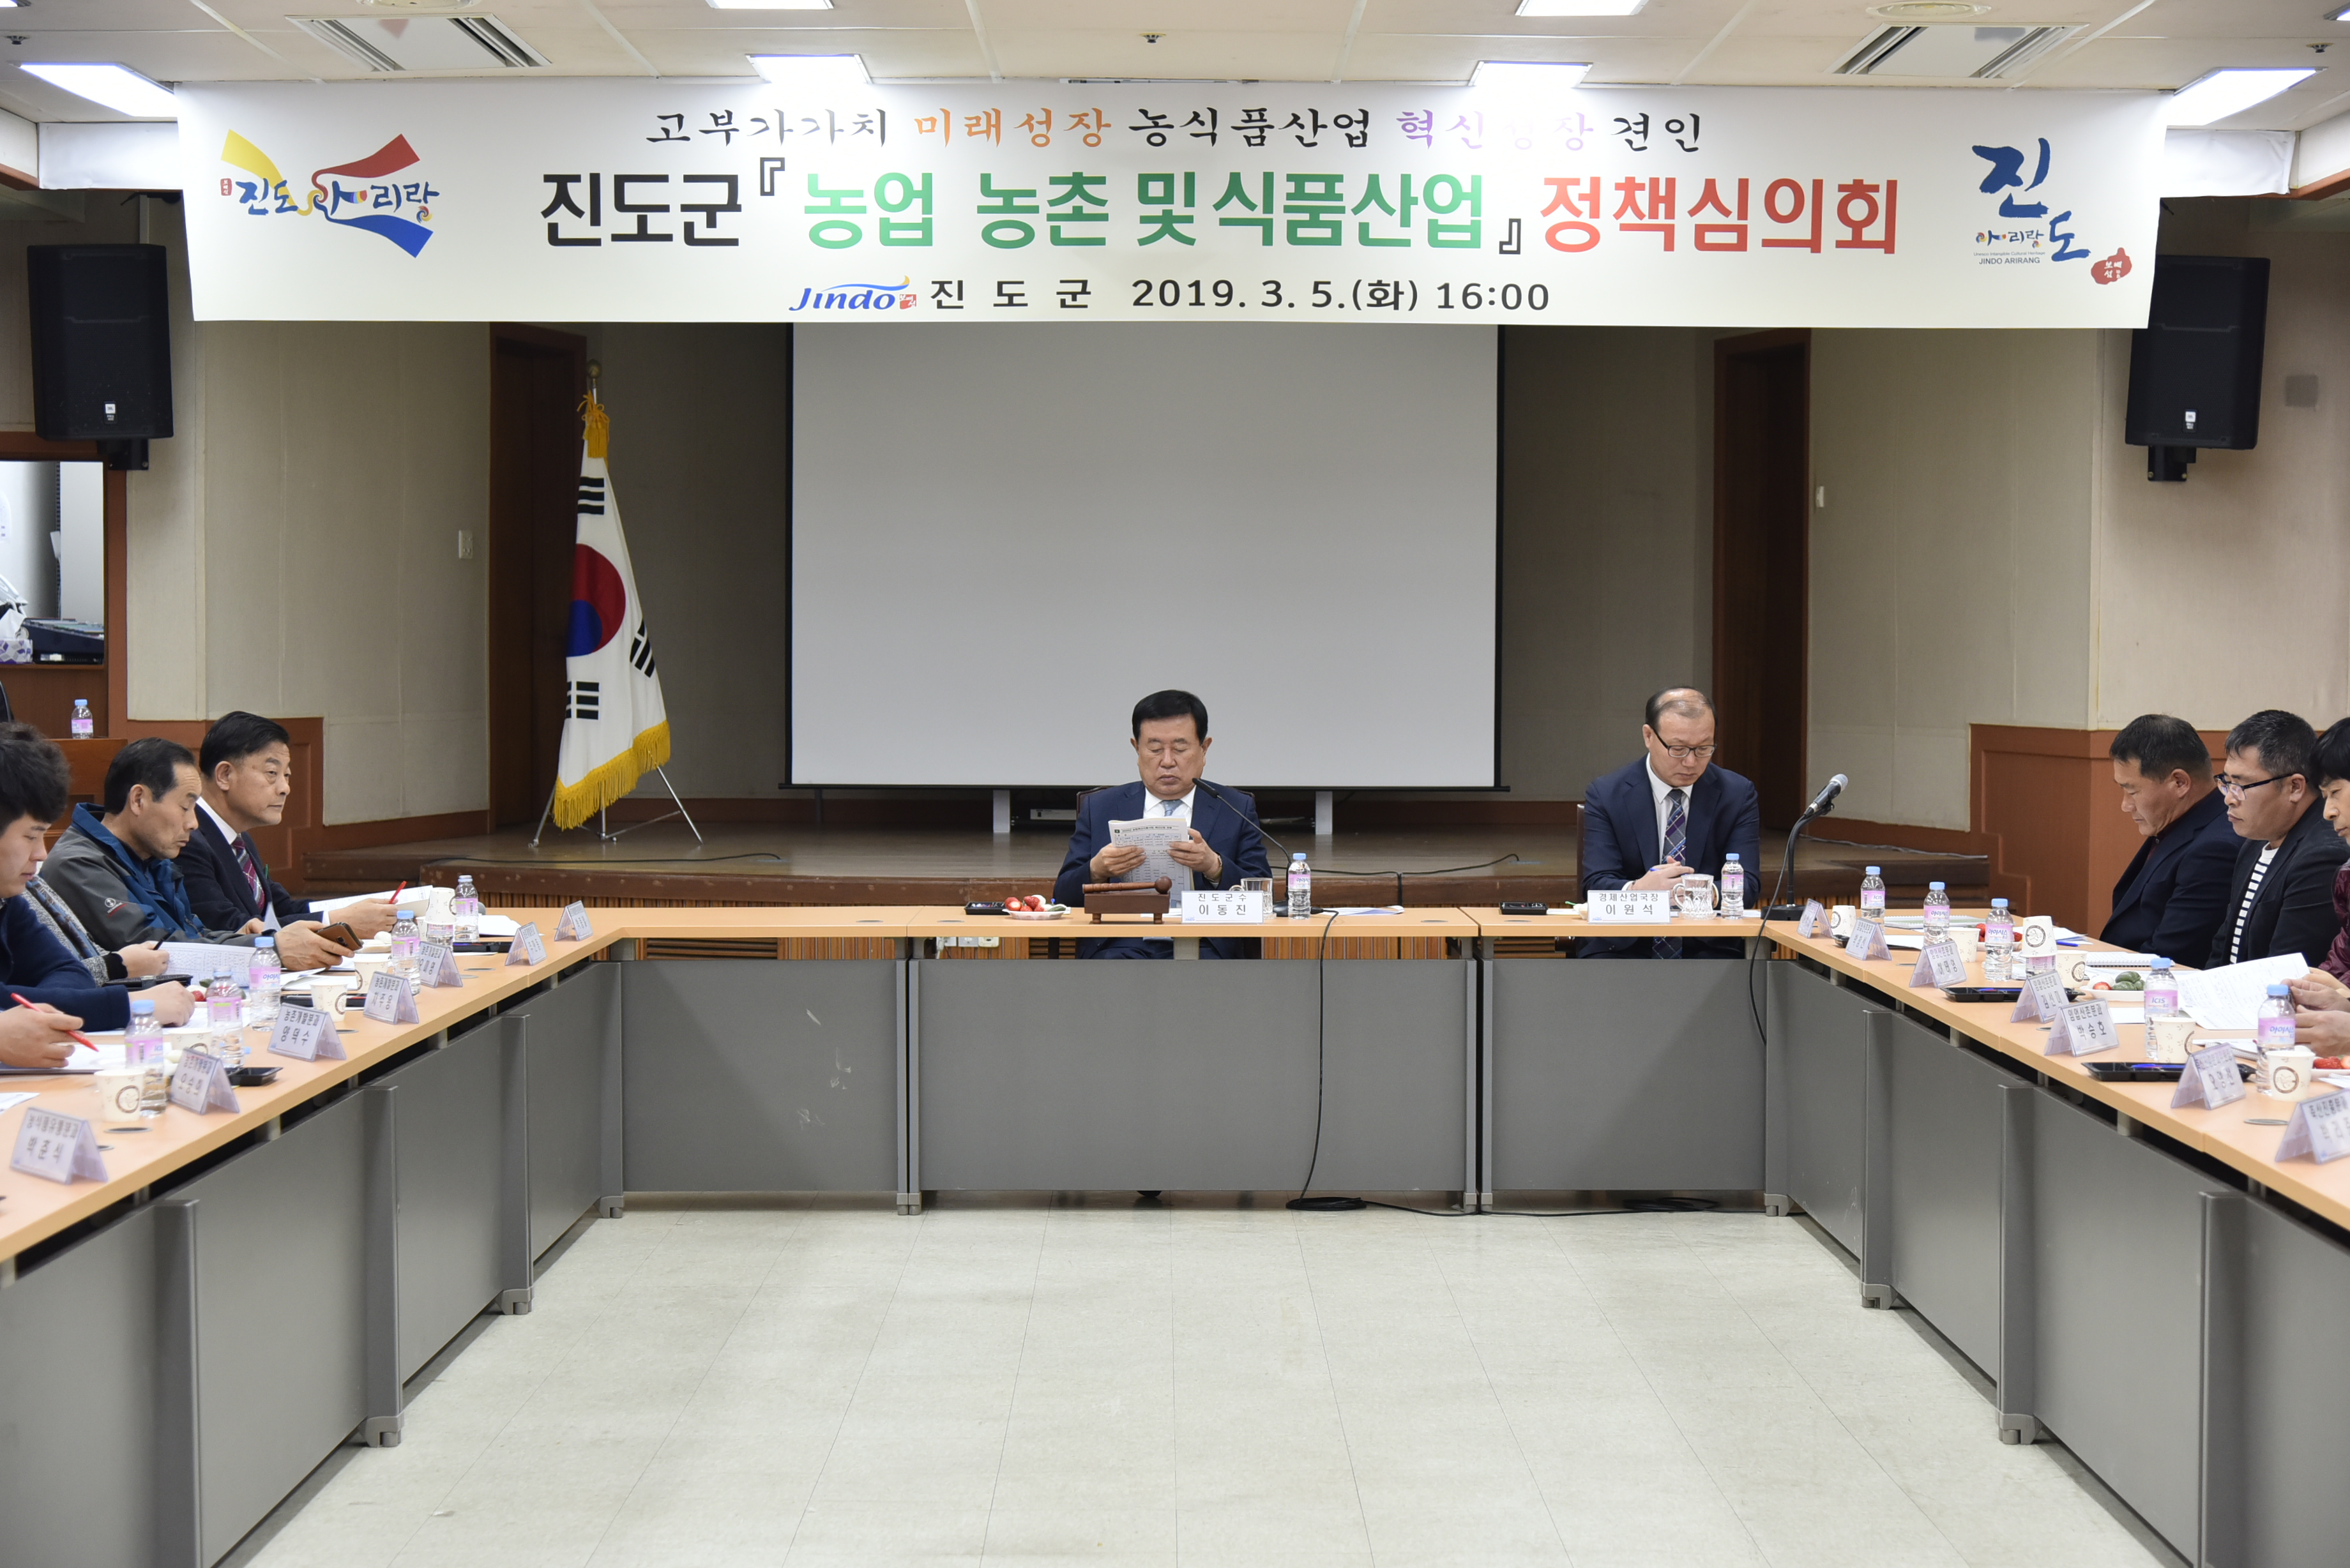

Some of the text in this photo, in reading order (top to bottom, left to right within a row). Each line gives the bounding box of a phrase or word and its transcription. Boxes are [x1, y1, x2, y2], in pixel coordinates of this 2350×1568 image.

[646, 109, 886, 147] 고부가가치
[914, 107, 1112, 148] 미래성장
[1128, 107, 1370, 149] 농식품산업
[1611, 112, 1700, 153] 견인
[976, 171, 1109, 250] 농촌
[1540, 176, 1898, 255] 정책심의회
[788, 287, 896, 312] Jindo
[1437, 282, 1549, 311] 16:00
[1599, 893, 1658, 902] 경제산업국장
[284, 1009, 320, 1027] 농촌개발분과
[2068, 1004, 2103, 1021] 임업산촌분과
